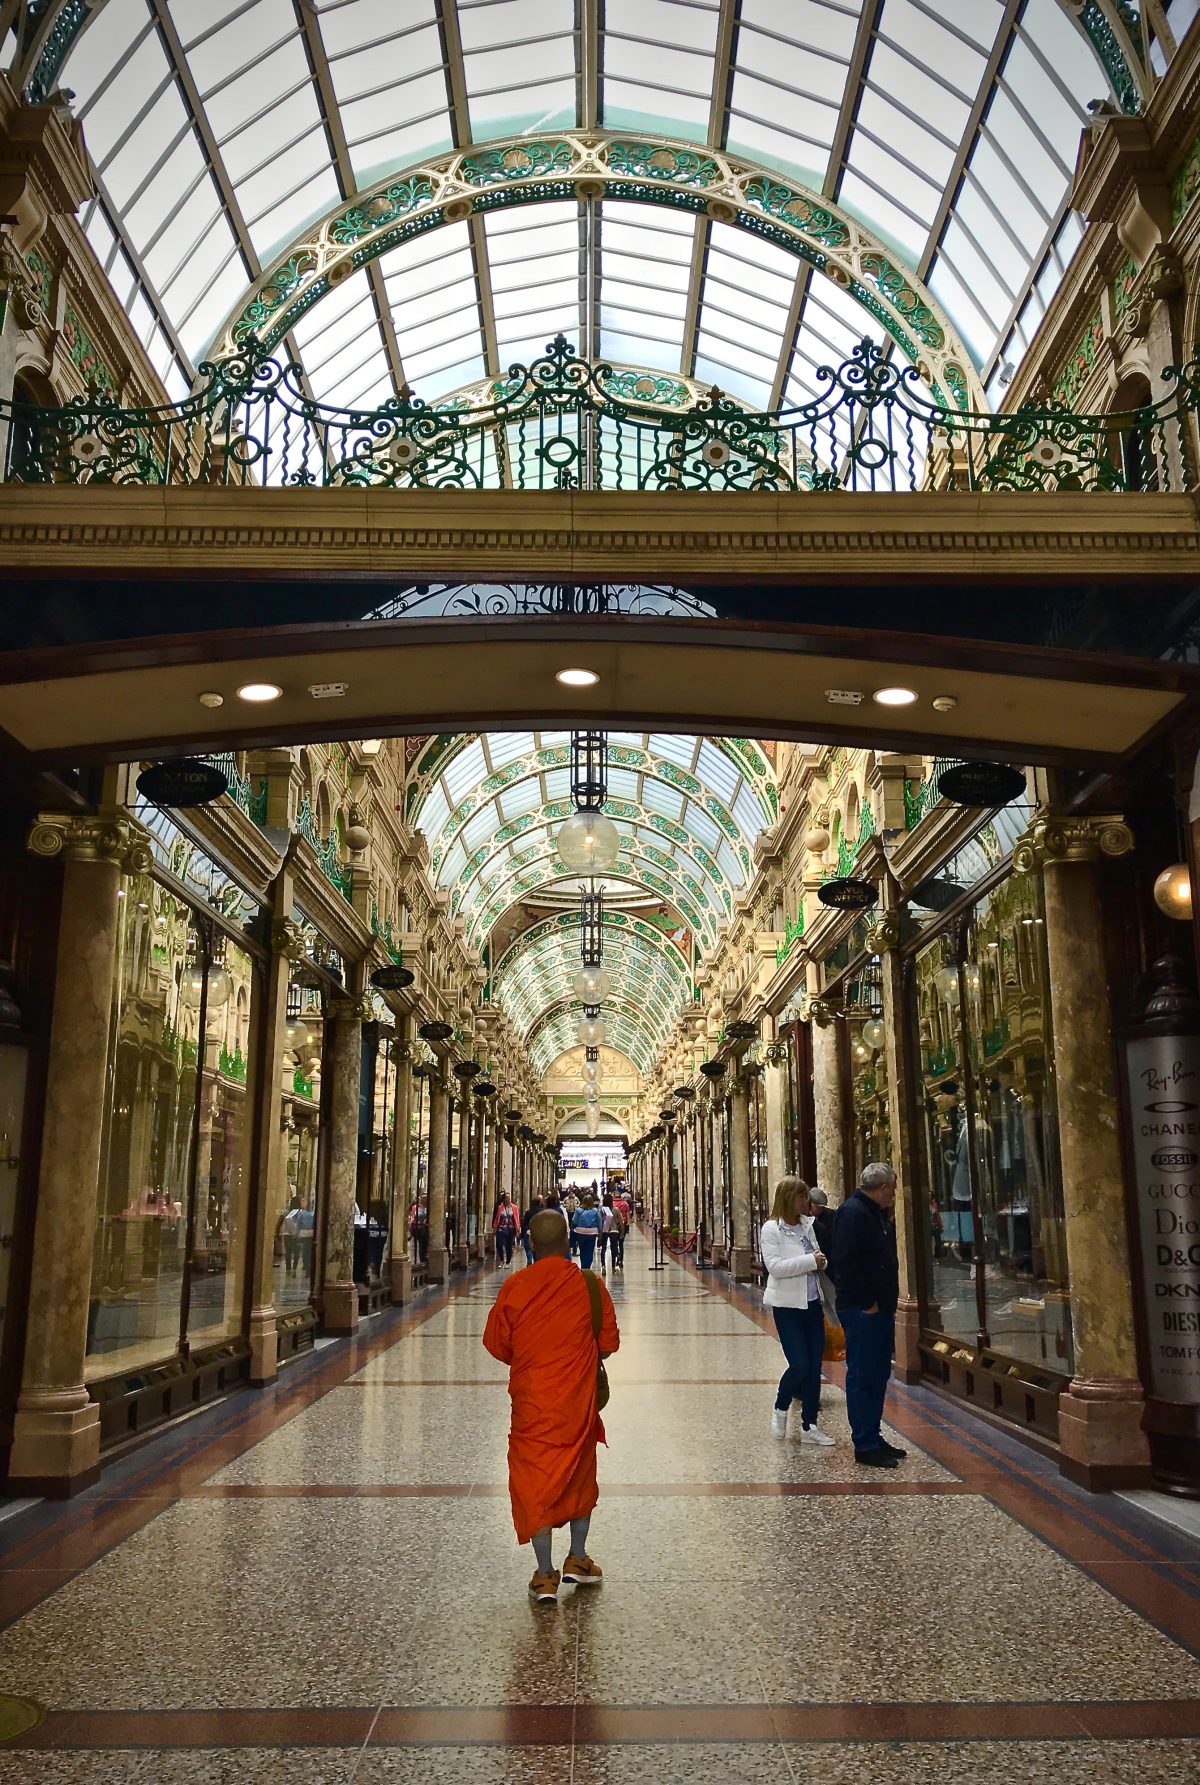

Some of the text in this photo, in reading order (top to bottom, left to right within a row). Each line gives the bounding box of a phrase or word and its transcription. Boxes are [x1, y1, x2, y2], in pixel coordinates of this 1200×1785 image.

[832, 886, 865, 895] IVER
[829, 894, 870, 902] WEENEY
[1141, 1061, 1197, 1090] Ray-Ban
[1141, 1123, 1200, 1137] CHANE
[1154, 1155, 1194, 1165] FOSSIL
[1154, 1209, 1199, 1234] Dio
[1163, 1312, 1200, 1331] DIES
[1159, 1345, 1186, 1358] TOM
